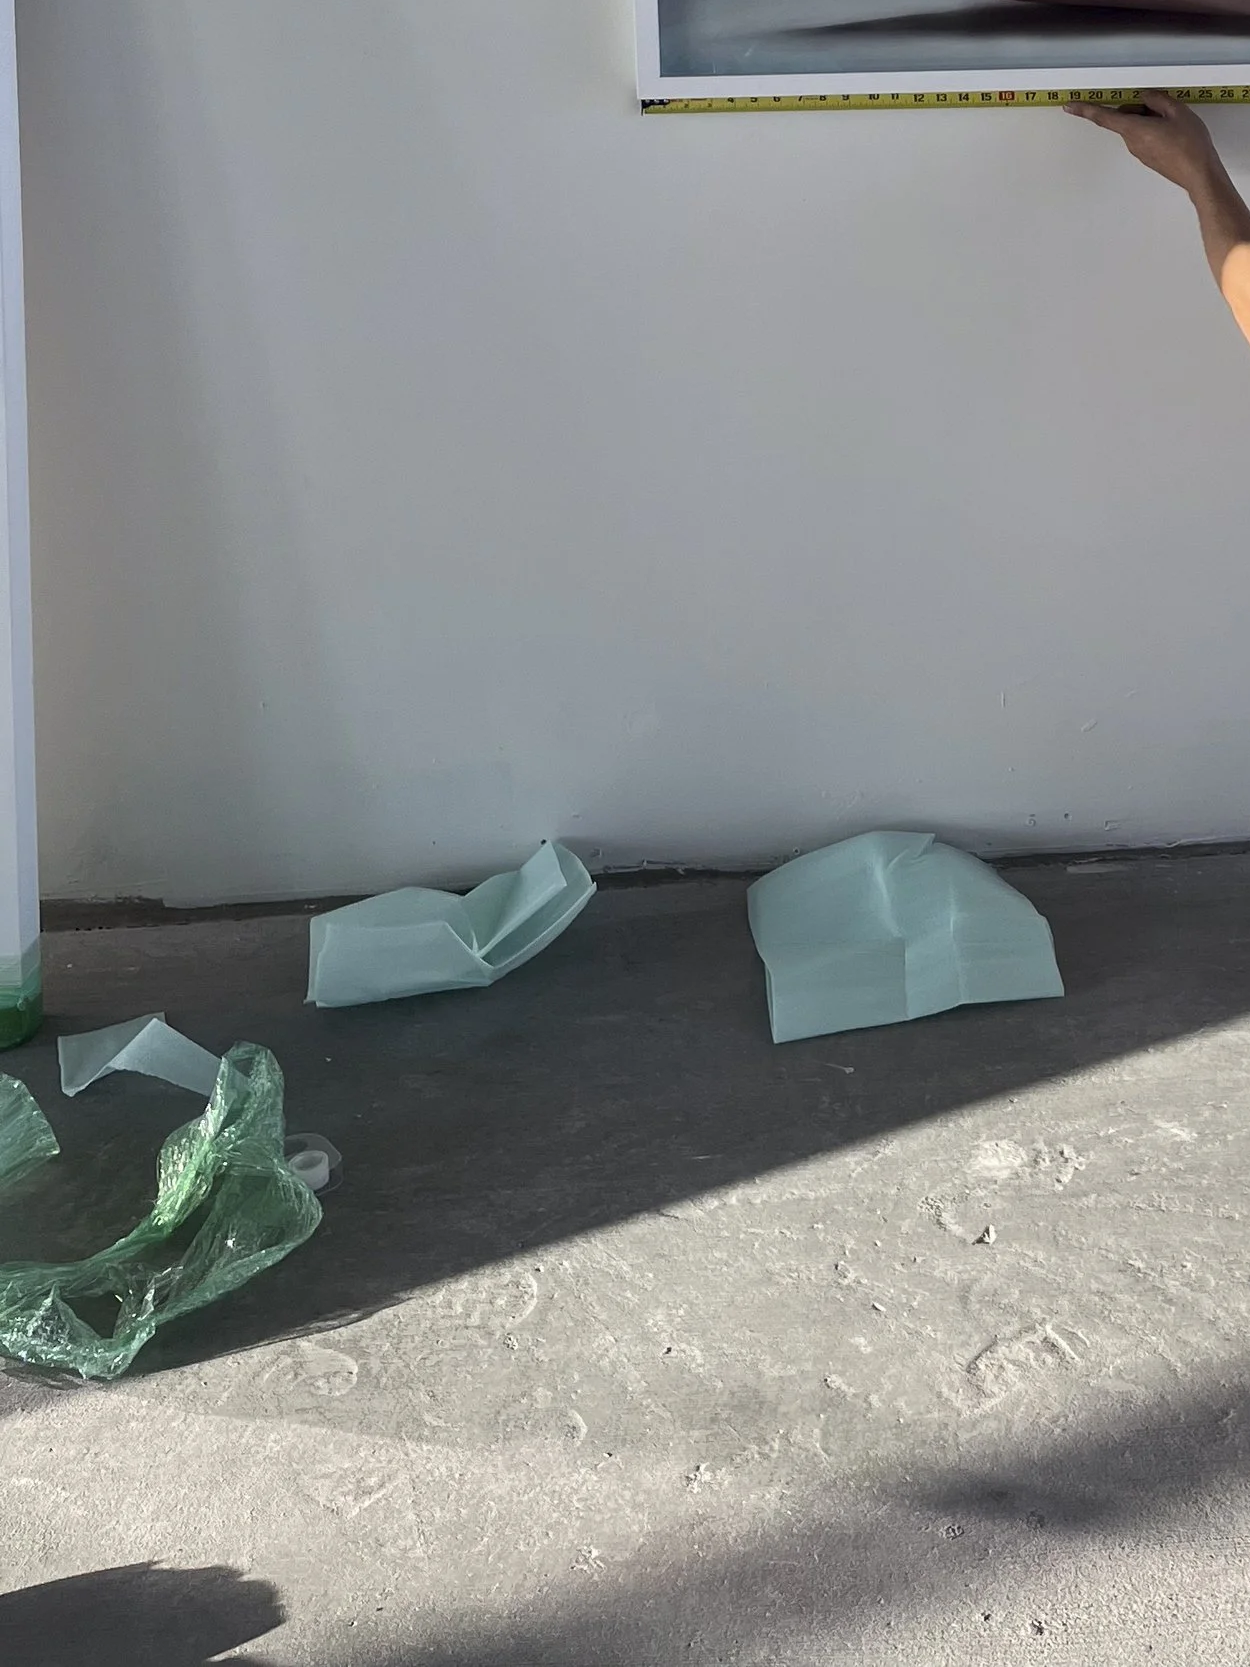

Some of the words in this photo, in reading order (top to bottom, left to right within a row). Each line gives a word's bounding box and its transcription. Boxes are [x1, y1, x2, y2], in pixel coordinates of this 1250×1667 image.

[913, 94, 925, 102] 12
[936, 93, 948, 102] 13
[958, 93, 970, 102] 14
[980, 93, 992, 101] 15
[1024, 92, 1037, 101] 17
[1047, 91, 1059, 100] 18
[1069, 91, 1081, 100] 19
[1088, 90, 1103, 100] 20
[1110, 90, 1122, 99] 21
[1176, 89, 1190, 98] 24
[1198, 89, 1213, 98] 25
[1220, 89, 1234, 98] 26
